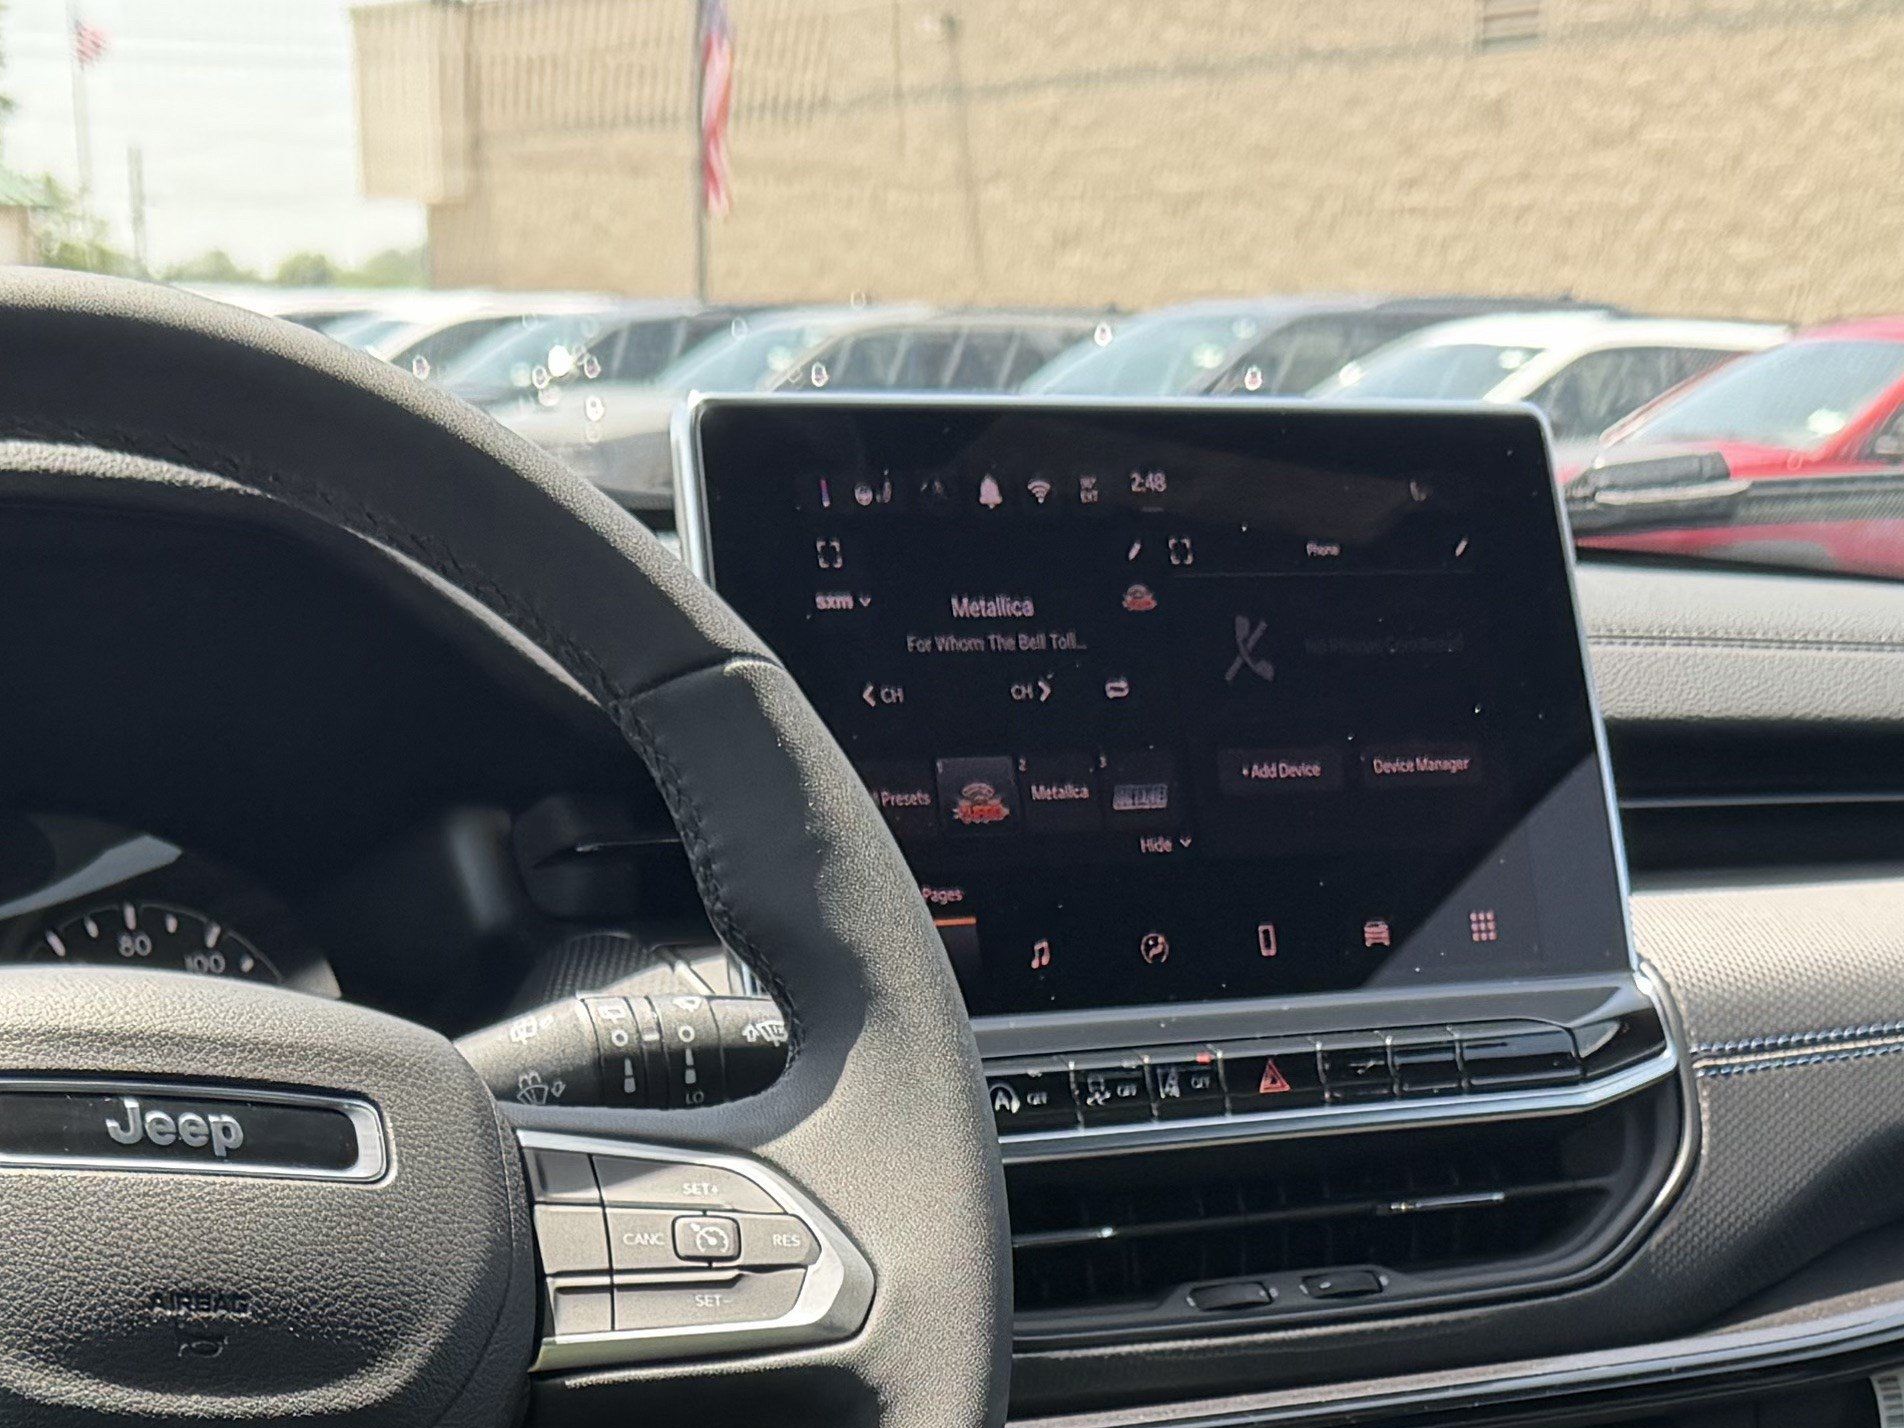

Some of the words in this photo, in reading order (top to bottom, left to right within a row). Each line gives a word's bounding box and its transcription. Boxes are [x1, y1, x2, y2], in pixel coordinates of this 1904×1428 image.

[1130, 471, 1167, 493] 2:48
[950, 593, 1035, 618] Metallica
[906, 634, 932, 653] For
[935, 634, 985, 652] Whom
[987, 633, 1016, 651] The
[1018, 632, 1047, 651] Bell
[880, 685, 905, 704] CH
[1251, 763, 1277, 779] Add
[1279, 761, 1322, 778] Device
[1373, 757, 1414, 775] Device
[1416, 754, 1472, 774] Manager
[880, 791, 932, 808] Presets
[1030, 783, 1091, 801] Metallica
[1139, 835, 1174, 854] Hide
[921, 886, 965, 905] Pages
[117, 930, 153, 958] 80
[183, 950, 226, 975] 100
[105, 1097, 244, 1157] Jeep
[683, 1182, 719, 1196] SET+
[623, 1233, 665, 1246] CANC
[772, 1233, 801, 1247] RES
